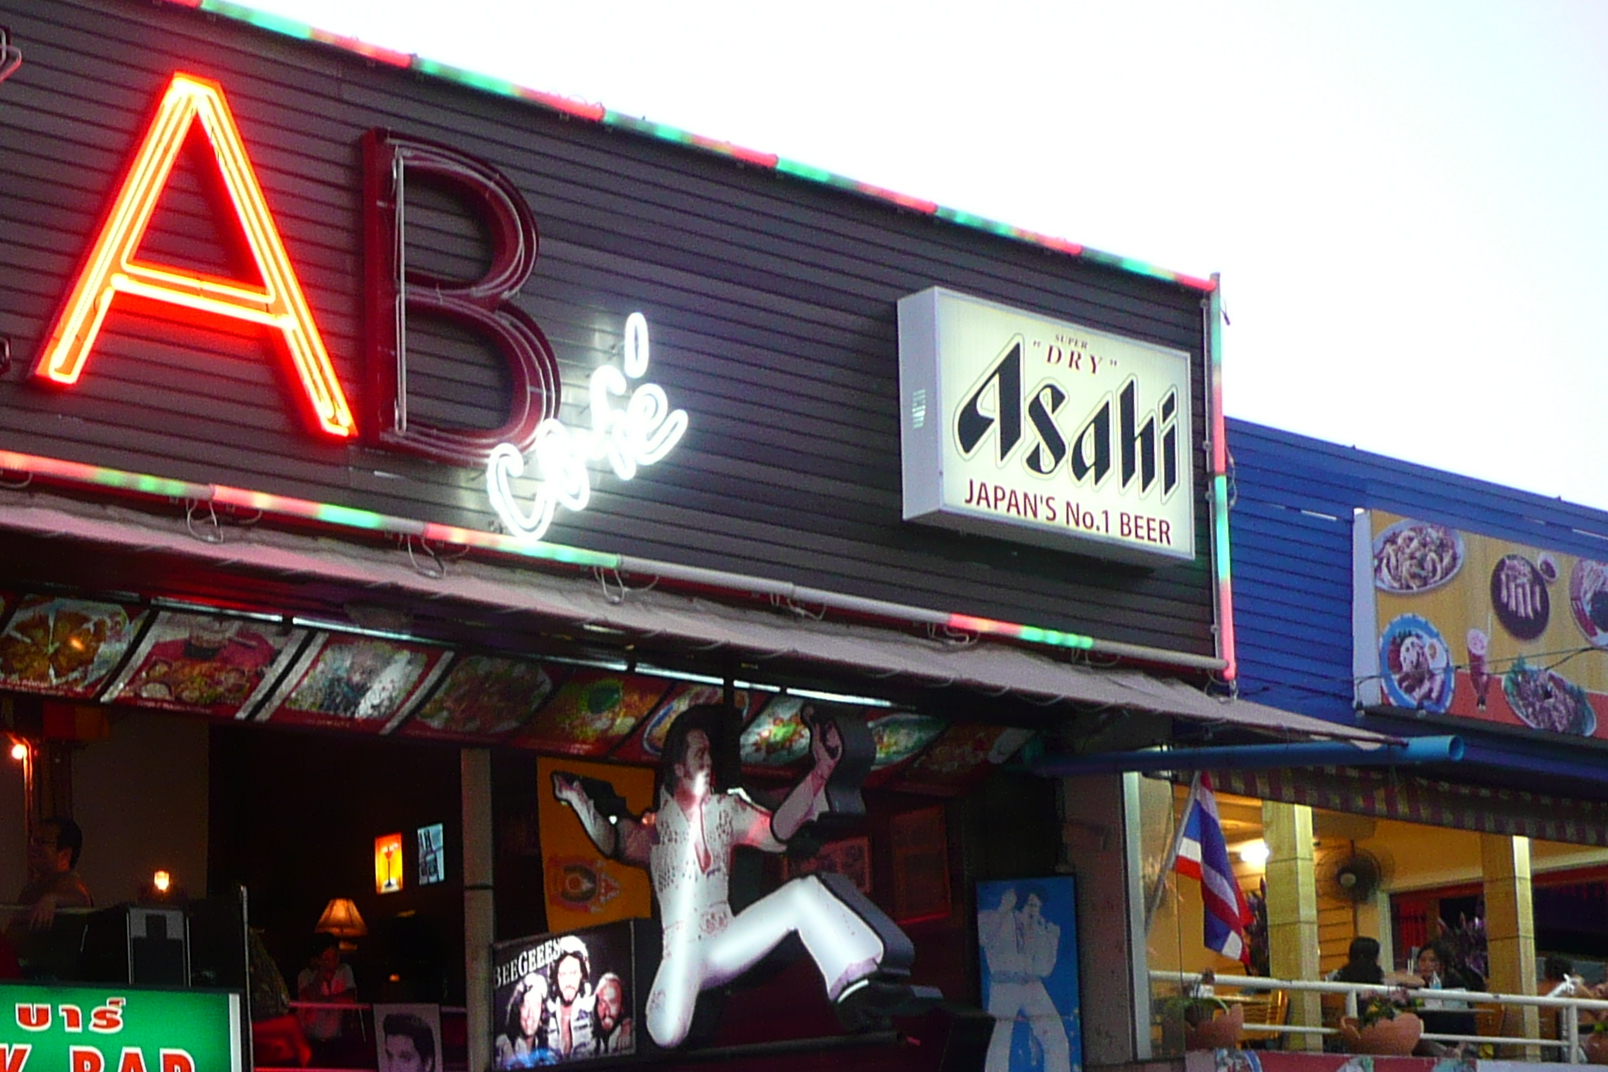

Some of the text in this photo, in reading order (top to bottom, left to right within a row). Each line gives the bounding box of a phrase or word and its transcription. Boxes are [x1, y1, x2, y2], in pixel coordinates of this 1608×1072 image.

[1054, 333, 1089, 350] SUPER
[954, 335, 1179, 502] Asahi
[964, 477, 1172, 546] JAPAN'S No.1 BEER
[15, 997, 127, 1033] บาร์
